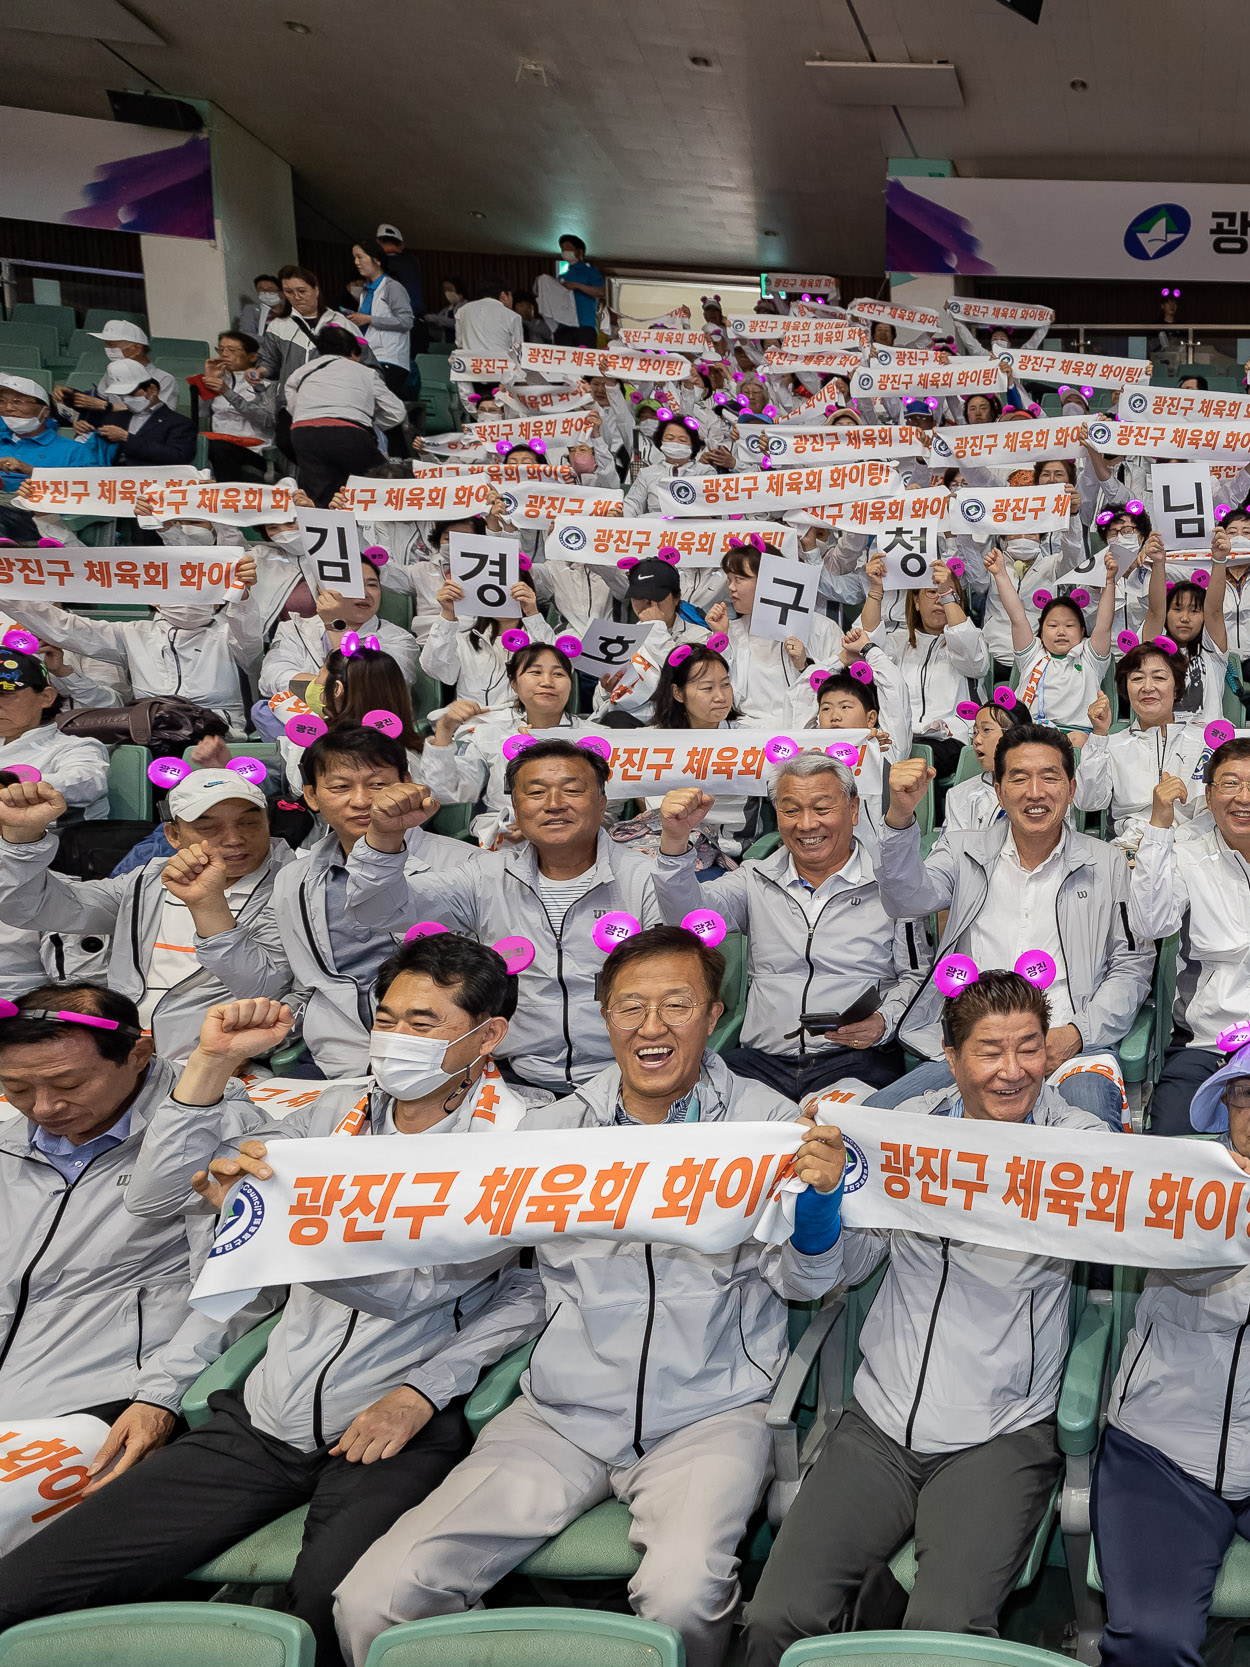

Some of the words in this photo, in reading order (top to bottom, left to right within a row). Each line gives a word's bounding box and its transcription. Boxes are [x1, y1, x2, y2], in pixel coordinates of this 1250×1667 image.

[957, 368, 998, 387] 화이팅!
[1152, 396, 1194, 416] 광진구
[1198, 400, 1241, 419] 체육회
[475, 424, 513, 443] 광진구
[519, 420, 557, 440] 체육회
[793, 432, 840, 453] 광진구
[846, 427, 892, 449] 체육회
[954, 434, 998, 459] 광진구
[1003, 429, 1049, 452] 체육회
[1117, 425, 1166, 446] 광진구
[1170, 428, 1220, 450] 체육회
[703, 476, 759, 503] 광진구
[766, 469, 822, 496] 체육회
[829, 463, 890, 490] 화이팅!
[197, 488, 262, 513] 체육회
[390, 486, 447, 510] 체육회
[992, 497, 1046, 522] 광진구
[1162, 482, 1205, 539] 님
[850, 500, 905, 525] 체육회
[305, 525, 350, 584] 김
[594, 529, 651, 554] 광진구
[657, 531, 716, 555] 체육회
[883, 527, 929, 578] 청
[84, 560, 168, 590] 체육회
[459, 552, 508, 608] 경
[760, 578, 809, 625] 구
[682, 747, 765, 780] 체육회
[605, 924, 628, 937] 광진
[693, 920, 716, 934] 광진
[946, 966, 967, 981] 광진
[1026, 961, 1047, 977] 광진
[880, 1142, 988, 1211] 광진구
[1002, 1156, 1133, 1232] 체육회
[288, 1171, 459, 1246] 광진구
[464, 1162, 649, 1236] 체육회
